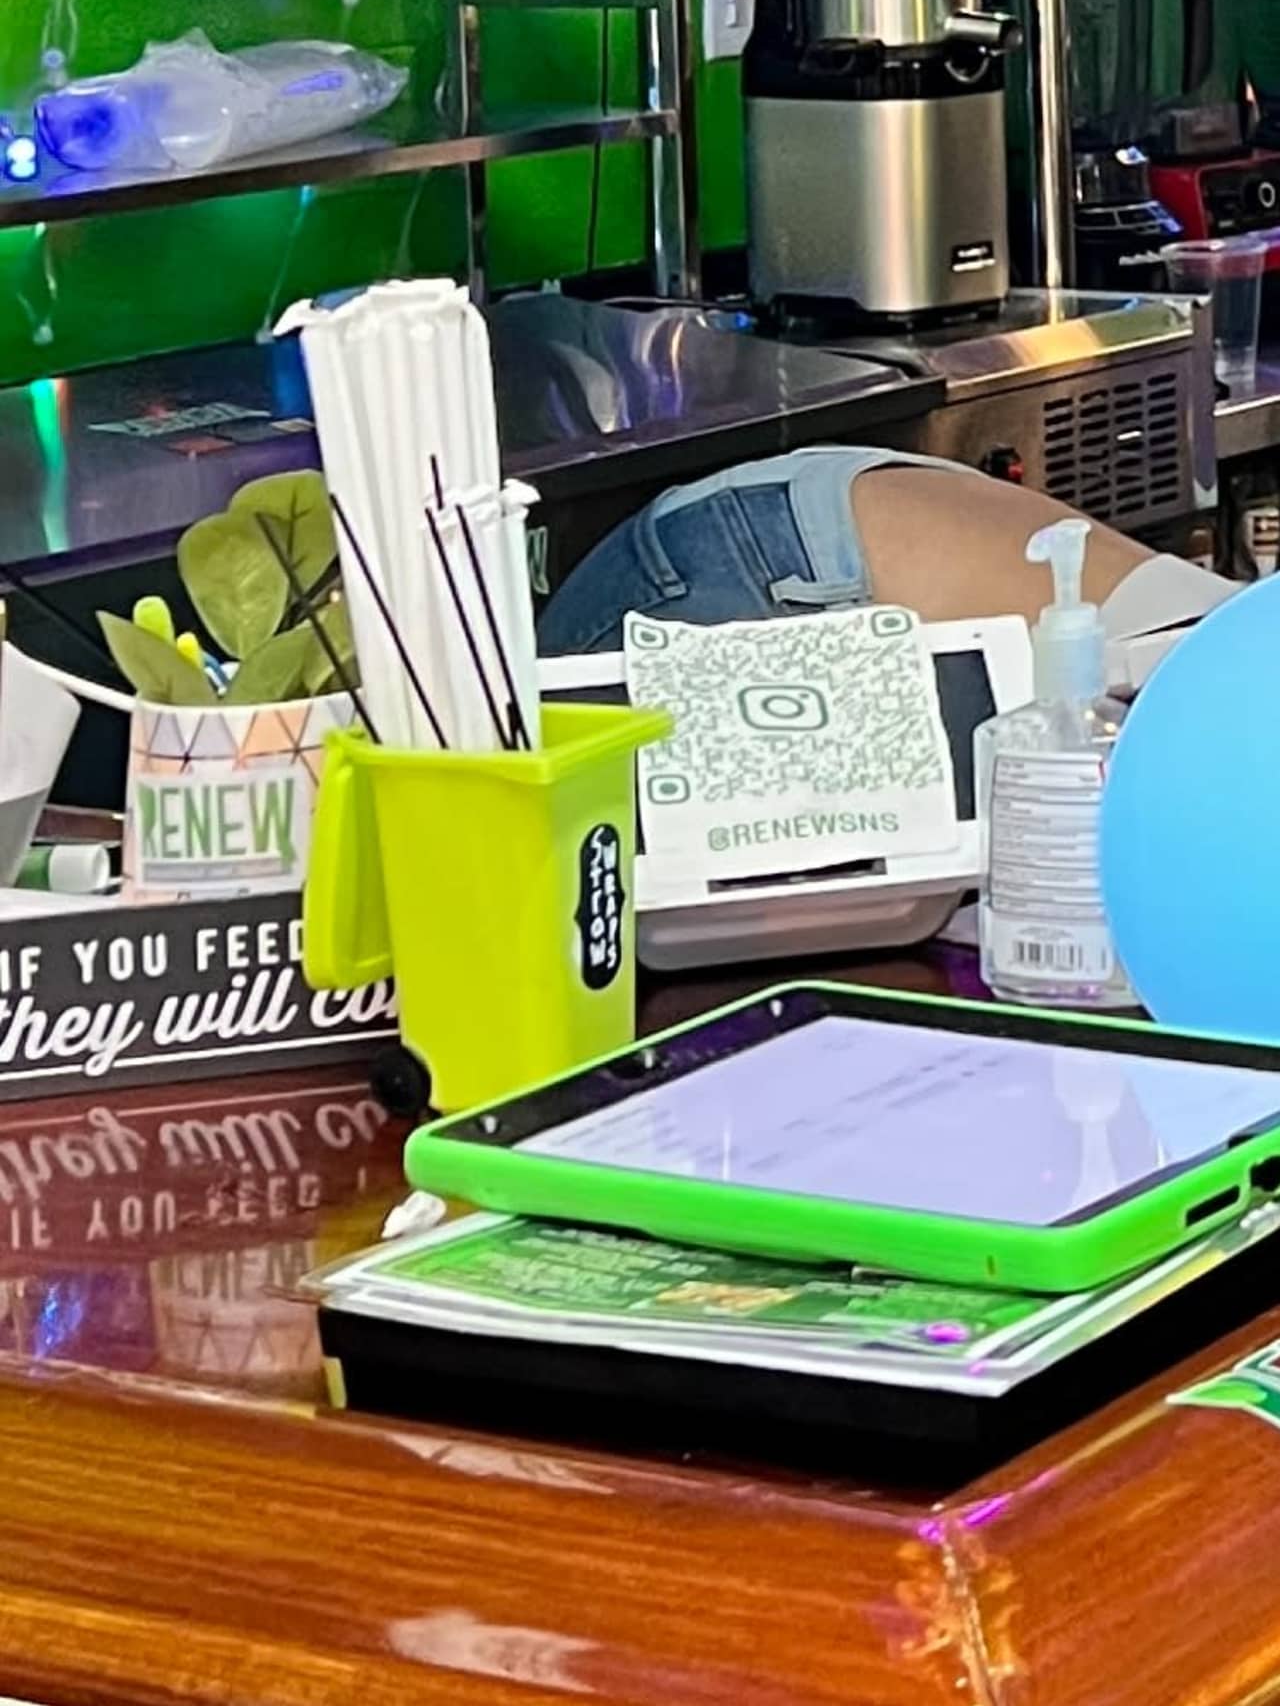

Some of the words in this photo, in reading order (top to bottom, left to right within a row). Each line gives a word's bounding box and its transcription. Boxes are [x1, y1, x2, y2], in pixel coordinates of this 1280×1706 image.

[137, 779, 296, 870] RENEW
[708, 812, 899, 851] @RENEWSNS
[0, 947, 41, 993] IF
[73, 933, 167, 984] YOU
[154, 967, 298, 1046] will
[311, 978, 398, 1028] co
